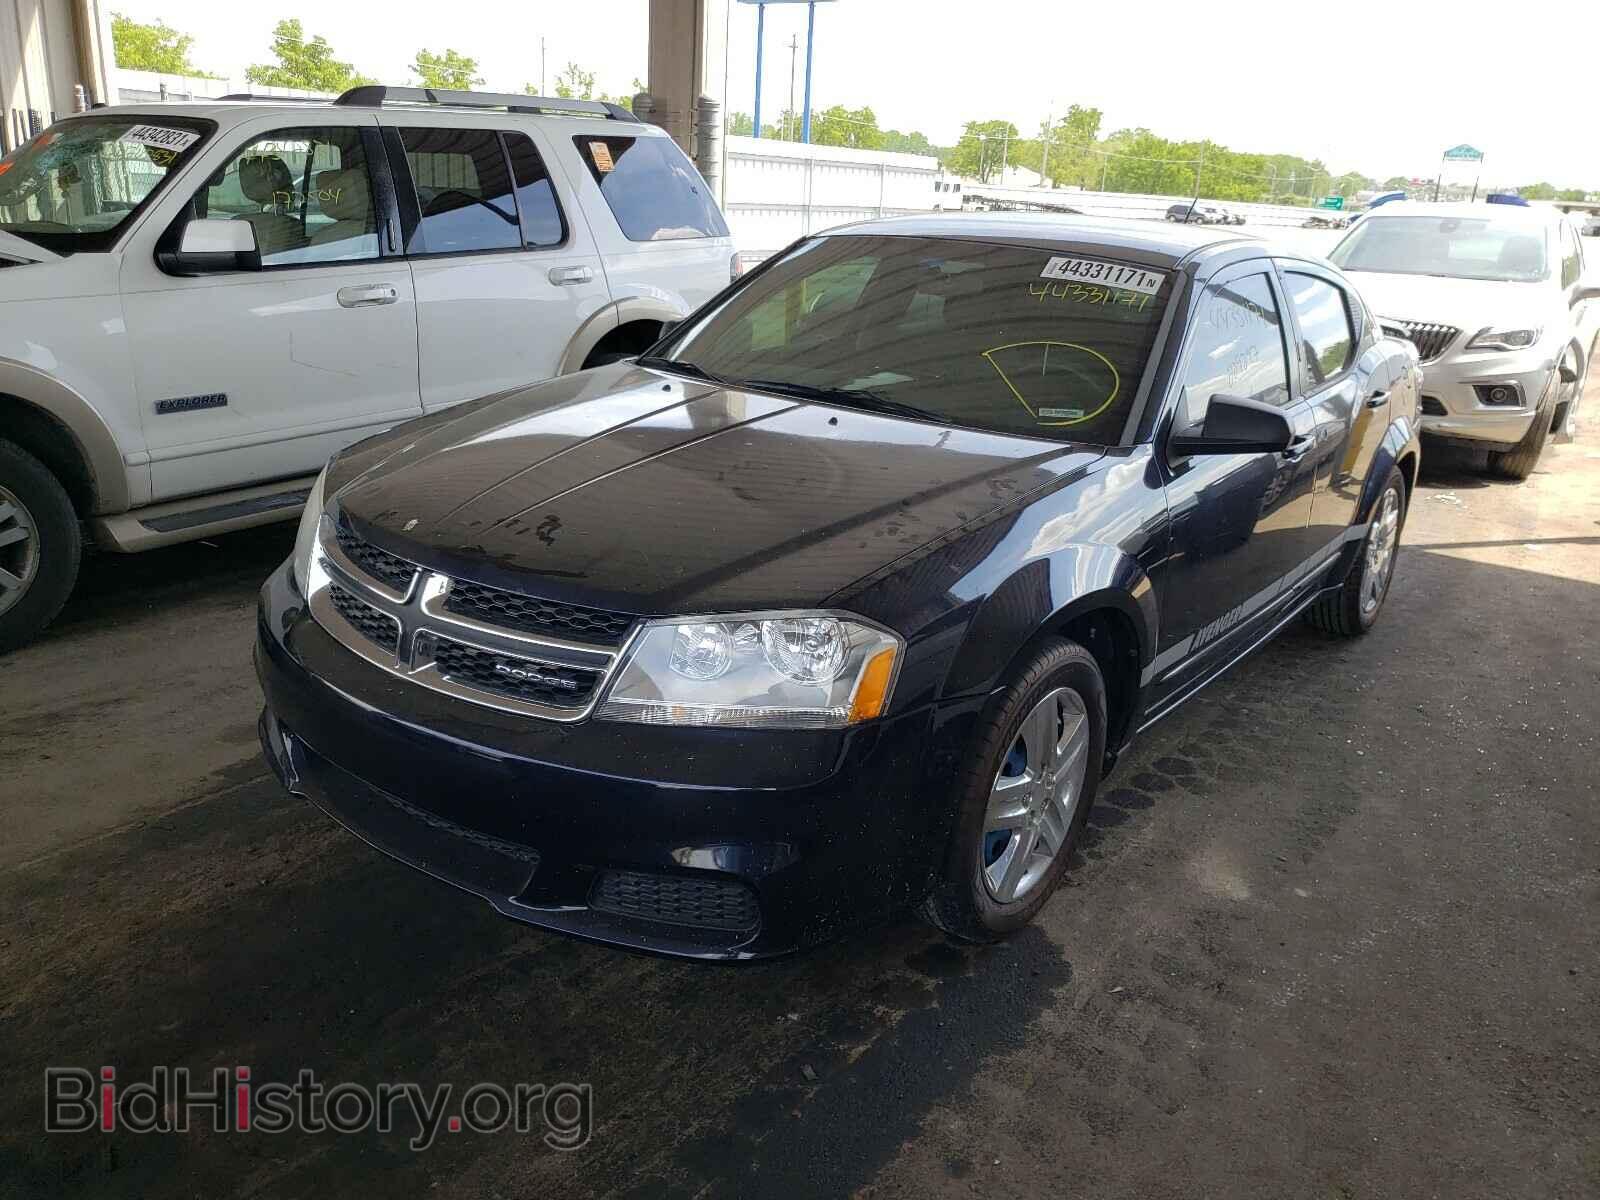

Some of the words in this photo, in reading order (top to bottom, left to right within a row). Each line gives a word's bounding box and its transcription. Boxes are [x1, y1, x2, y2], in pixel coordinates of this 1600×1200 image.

[1058, 260, 1146, 287] 44331171
[1146, 279, 1157, 288] N
[1029, 281, 1150, 312] 44331171
[158, 392, 227, 410] EXPLORER
[495, 664, 577, 689] DODGE
